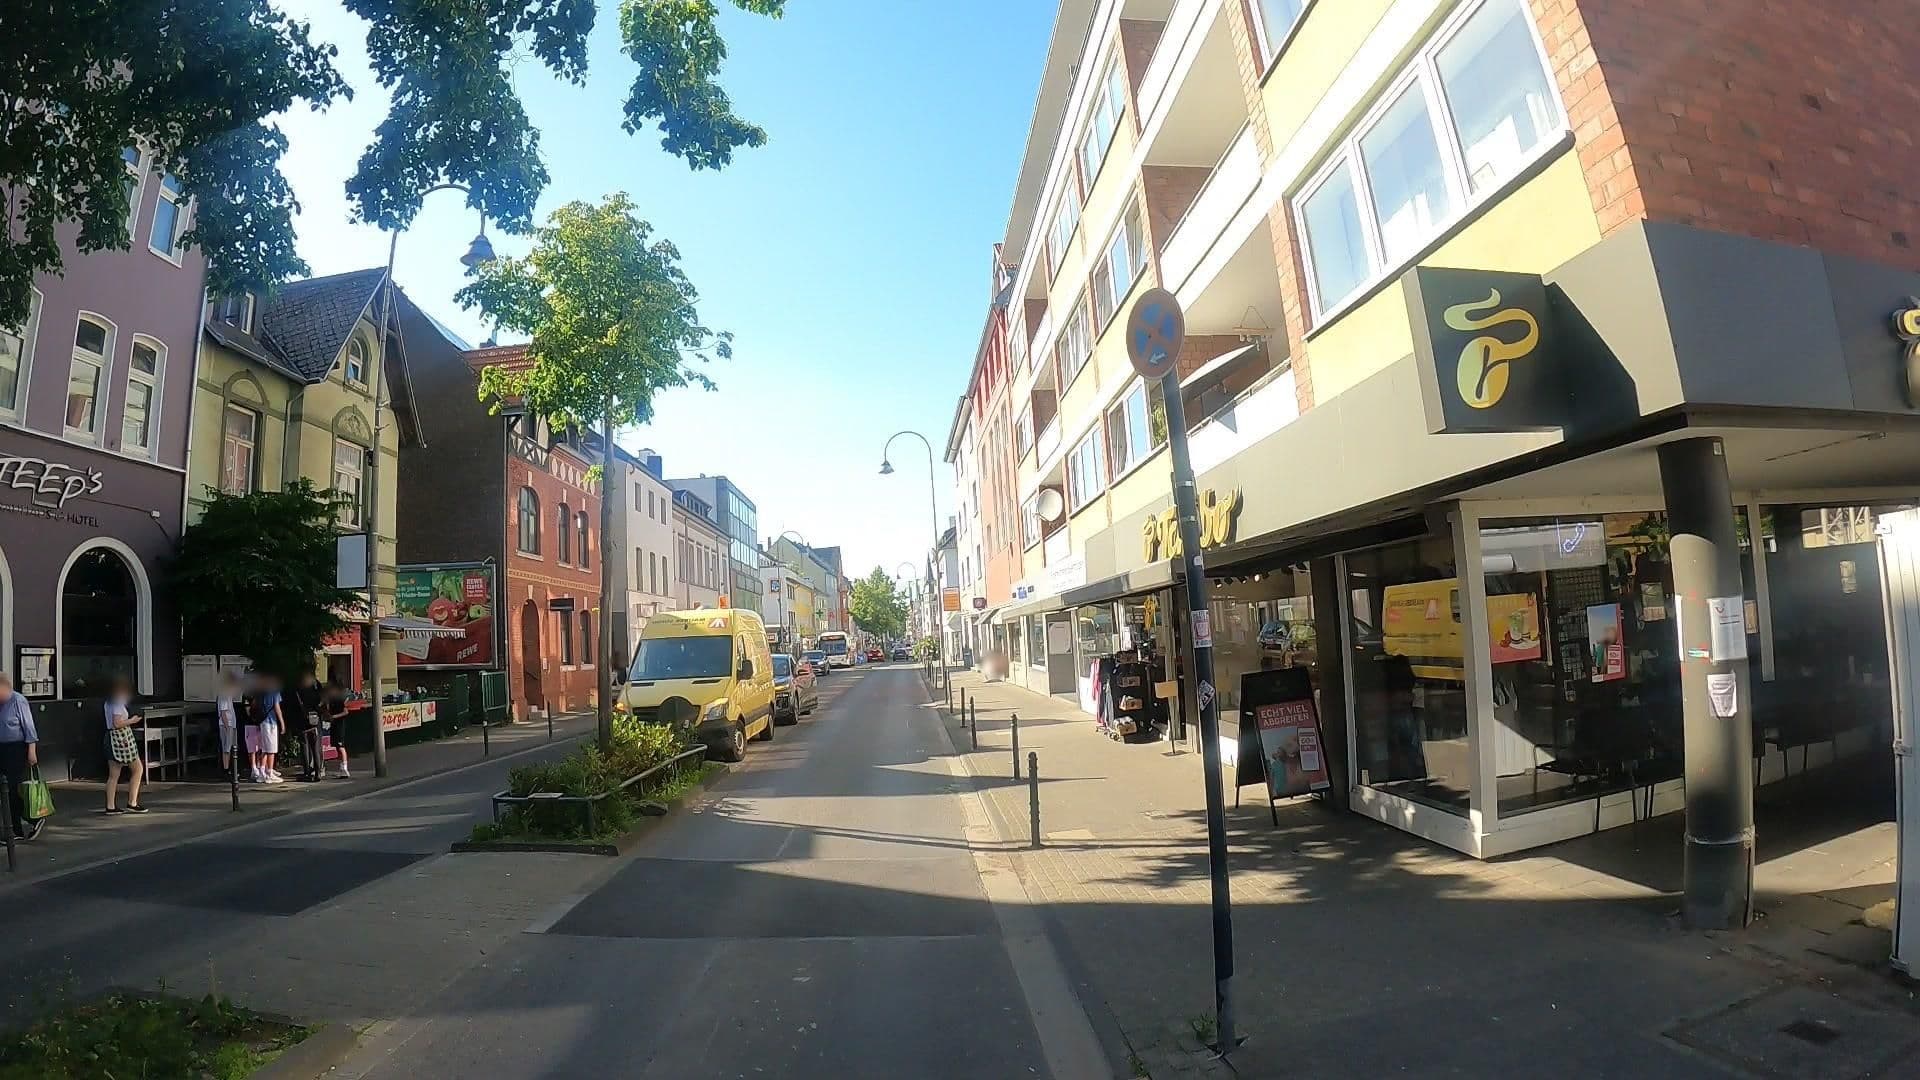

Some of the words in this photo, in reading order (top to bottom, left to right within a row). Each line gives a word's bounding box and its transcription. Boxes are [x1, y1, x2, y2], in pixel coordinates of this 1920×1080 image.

[66, 512, 99, 528] HOTEL
[456, 643, 479, 662] REWE
[1261, 707, 1285, 719] ECHT
[1286, 704, 1308, 715] VIEL
[1263, 712, 1309, 727] ABGREIFEN
